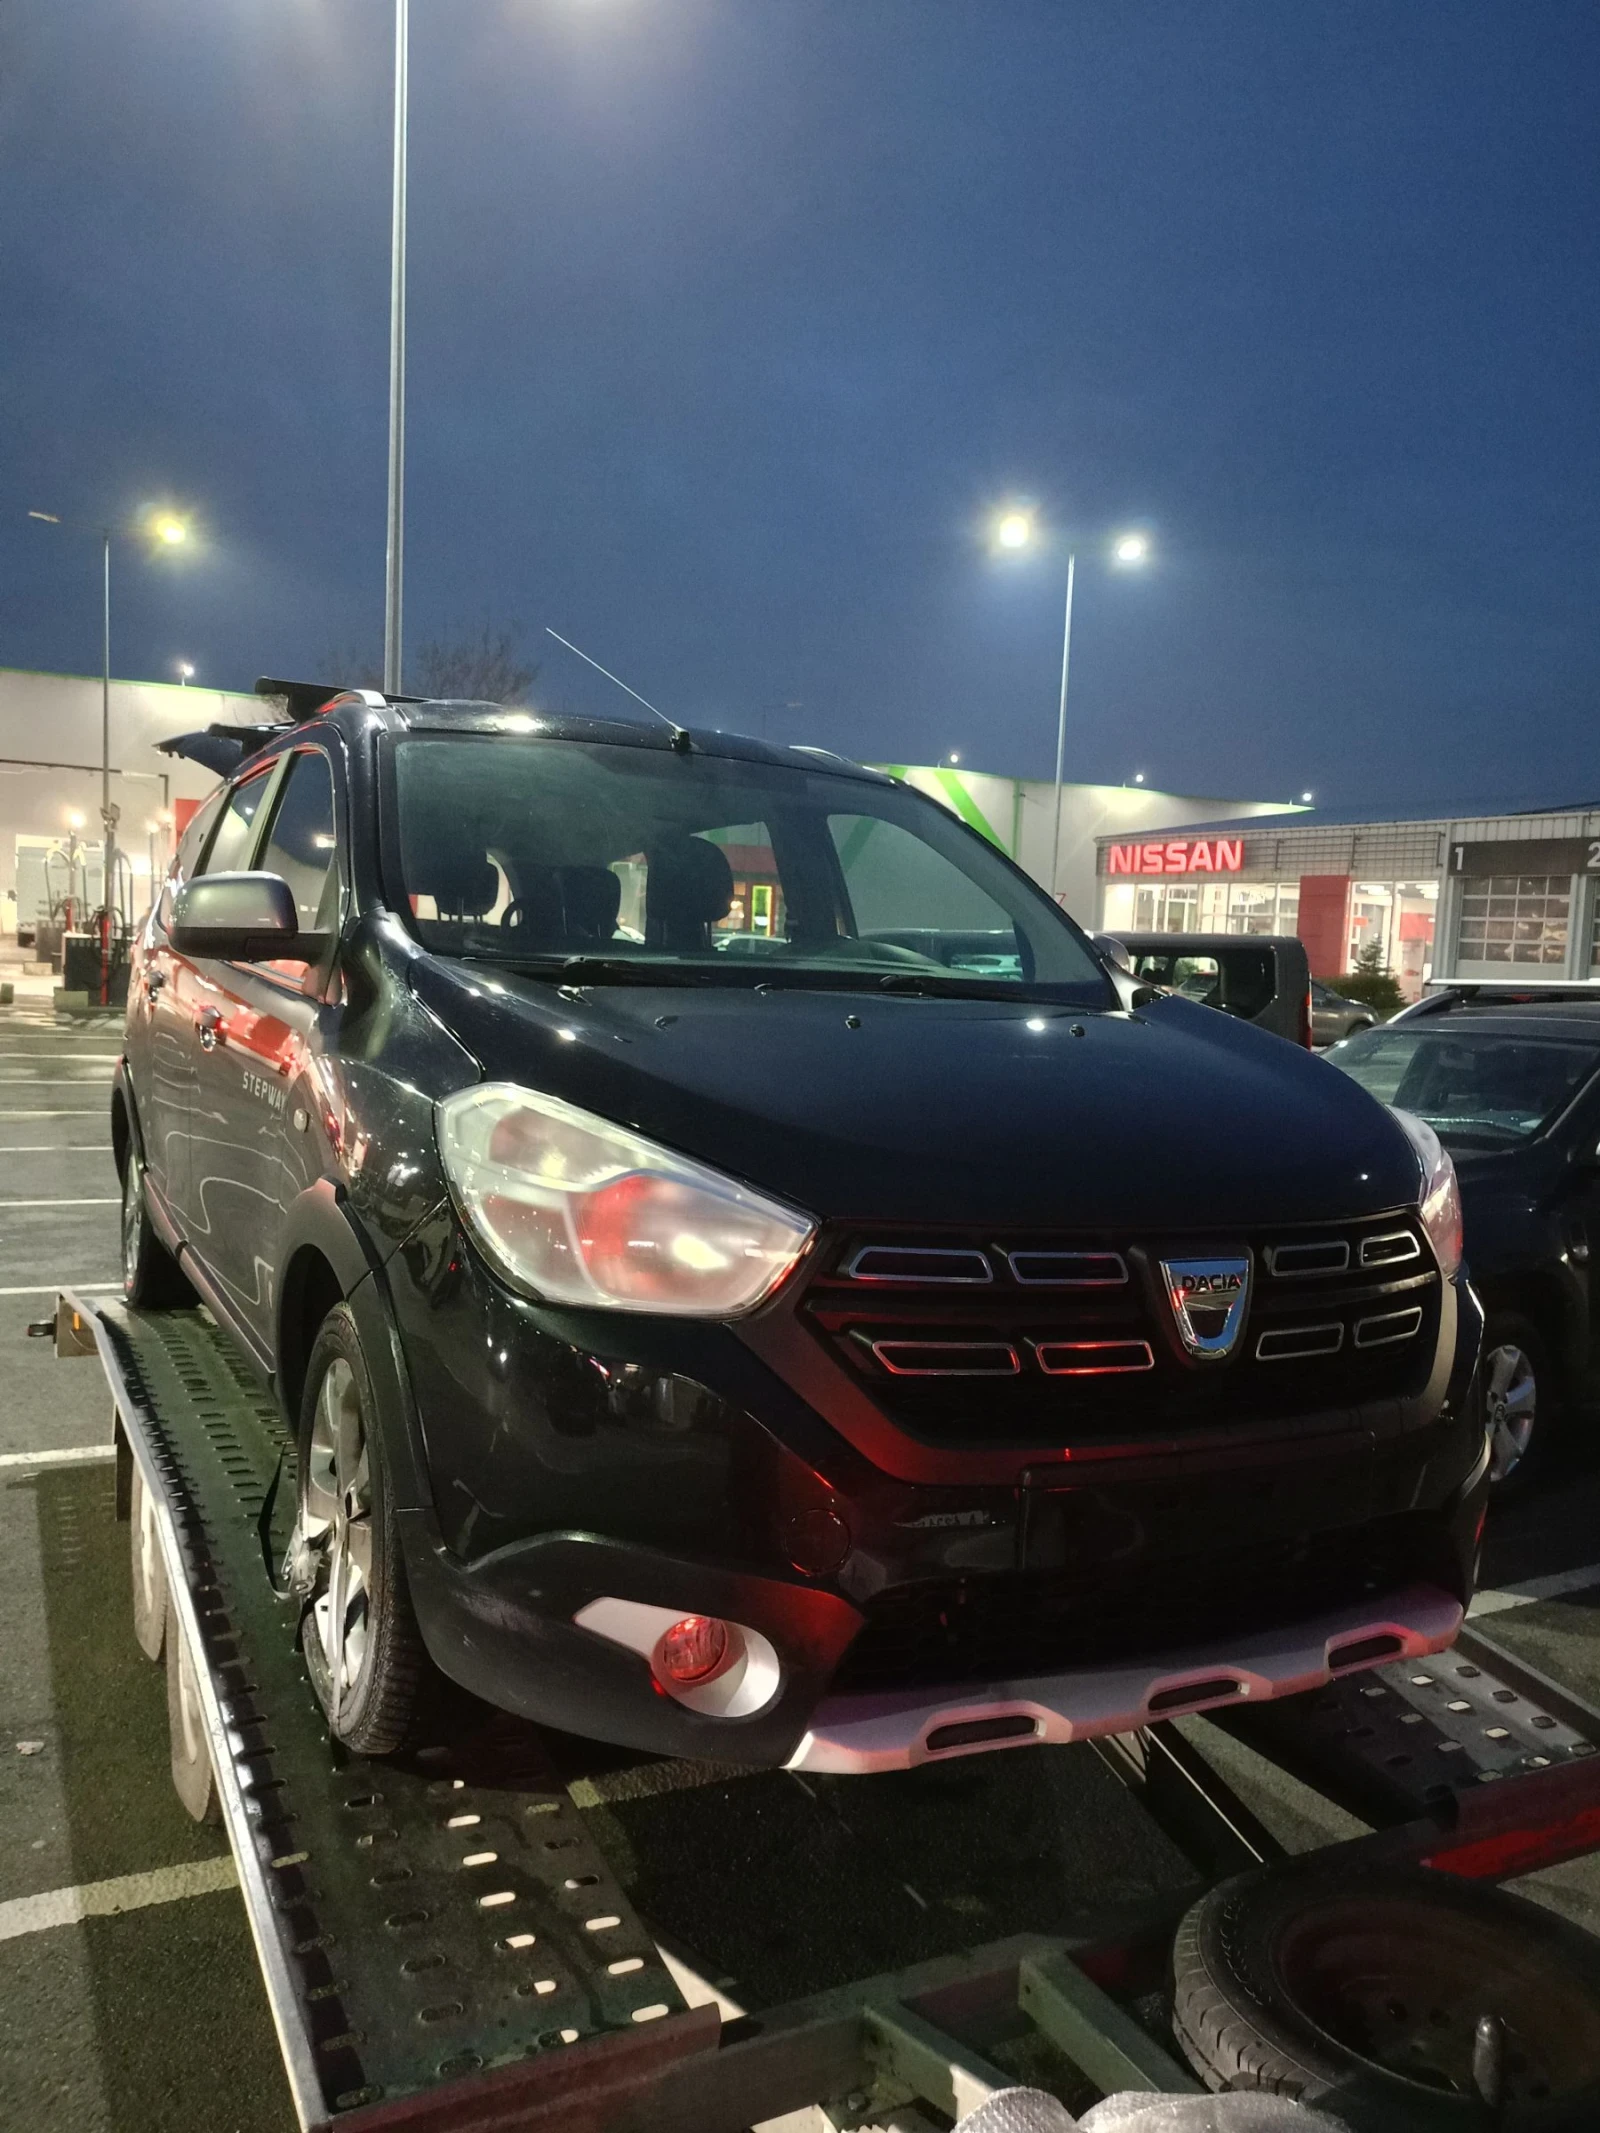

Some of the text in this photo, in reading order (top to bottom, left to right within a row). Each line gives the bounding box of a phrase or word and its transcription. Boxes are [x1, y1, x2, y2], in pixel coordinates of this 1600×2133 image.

[1109, 840, 1243, 874] NISSAN
[1455, 846, 1464, 871] 1
[1587, 841, 1600, 868] 2
[242, 1071, 287, 1113] STEPWAY
[1182, 1273, 1243, 1290] DACIA
